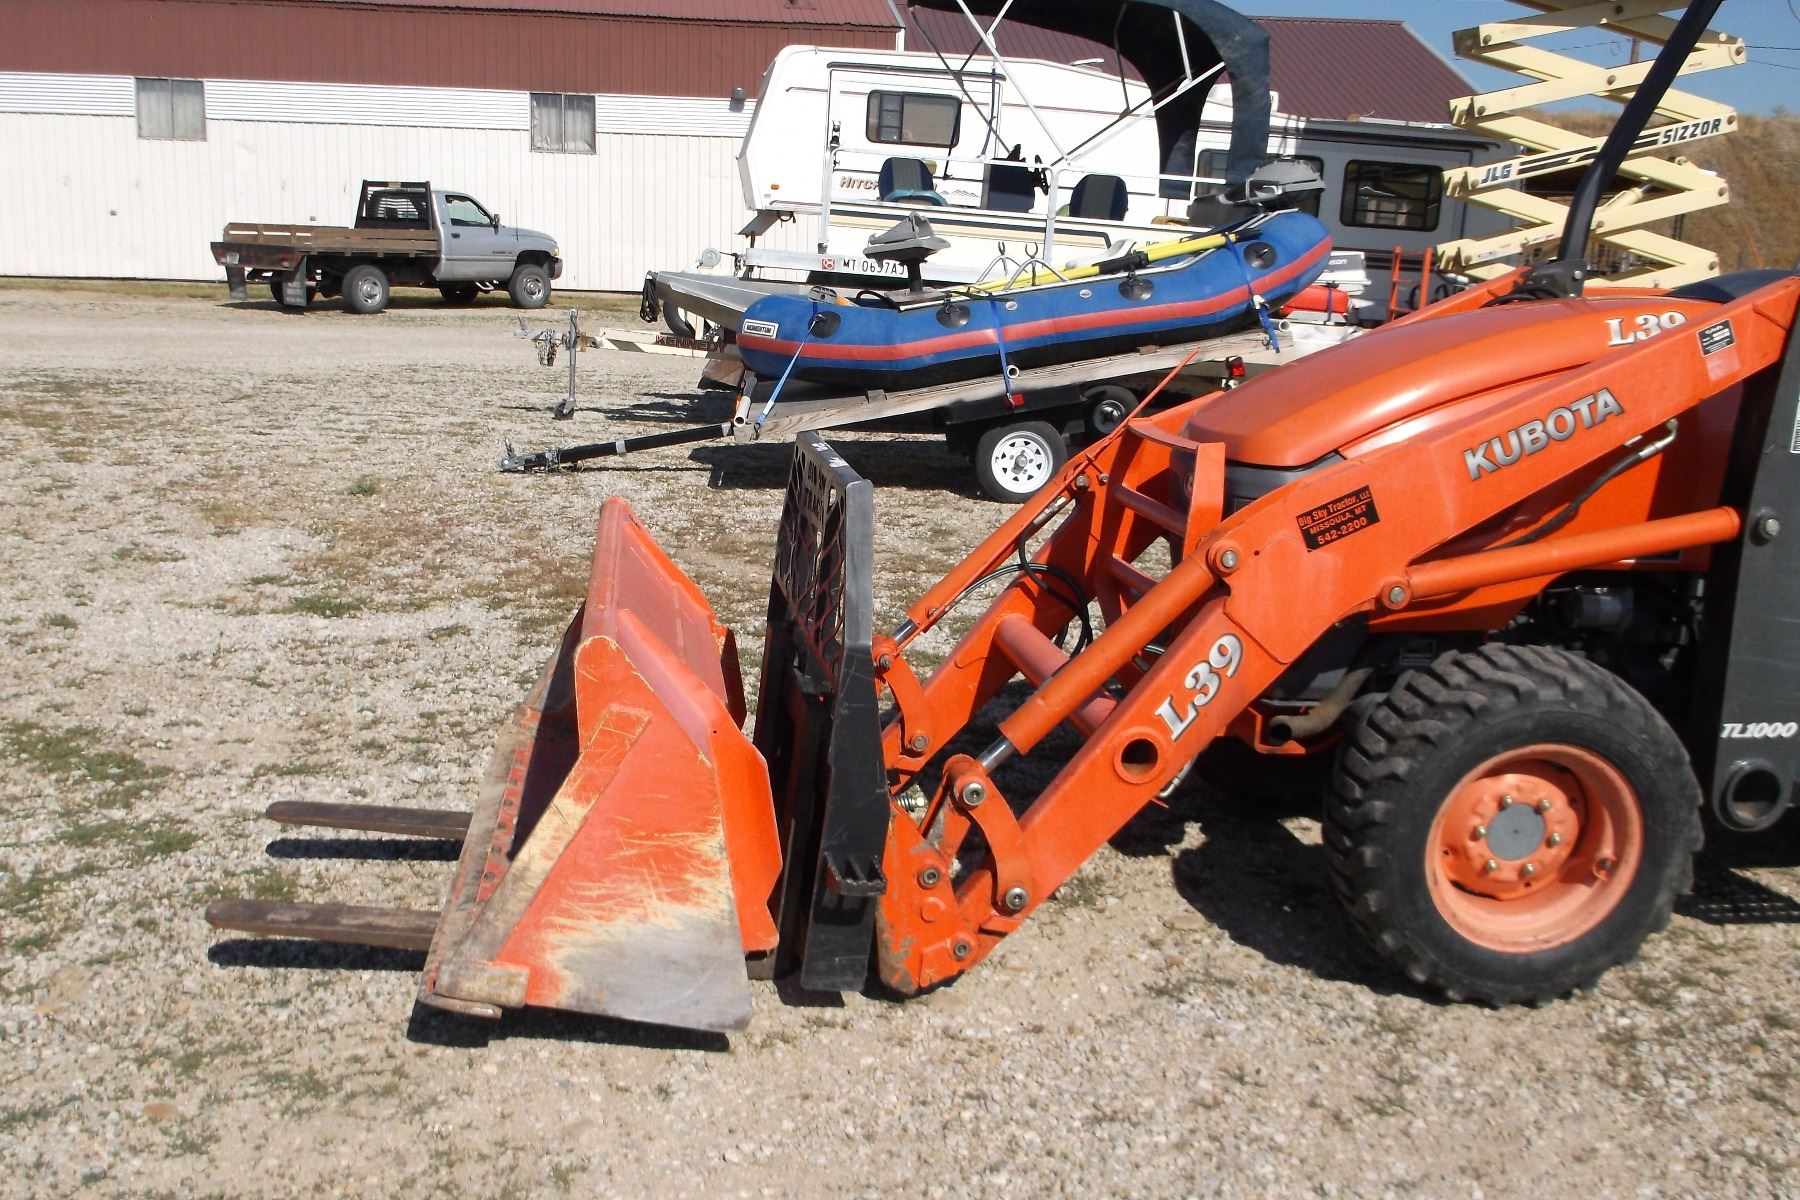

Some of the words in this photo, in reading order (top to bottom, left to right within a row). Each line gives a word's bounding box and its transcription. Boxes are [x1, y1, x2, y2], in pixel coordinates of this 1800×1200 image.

[1480, 163, 1512, 185] JLG
[1661, 118, 1722, 145] SIZZOR
[843, 258, 857, 271] MT
[655, 334, 727, 353] KENNEDY
[1463, 388, 1625, 481] KUBOTA
[1298, 515, 1313, 527] Big
[1312, 508, 1328, 521] Sky
[1327, 495, 1359, 513] Tractor,
[1359, 490, 1371, 500] LLC
[1309, 512, 1354, 535] MISSOULA,
[1354, 504, 1367, 515] MT
[1317, 517, 1368, 545] 542-2200
[1154, 633, 1243, 741] L39
[1720, 722, 1799, 738] TL1000
